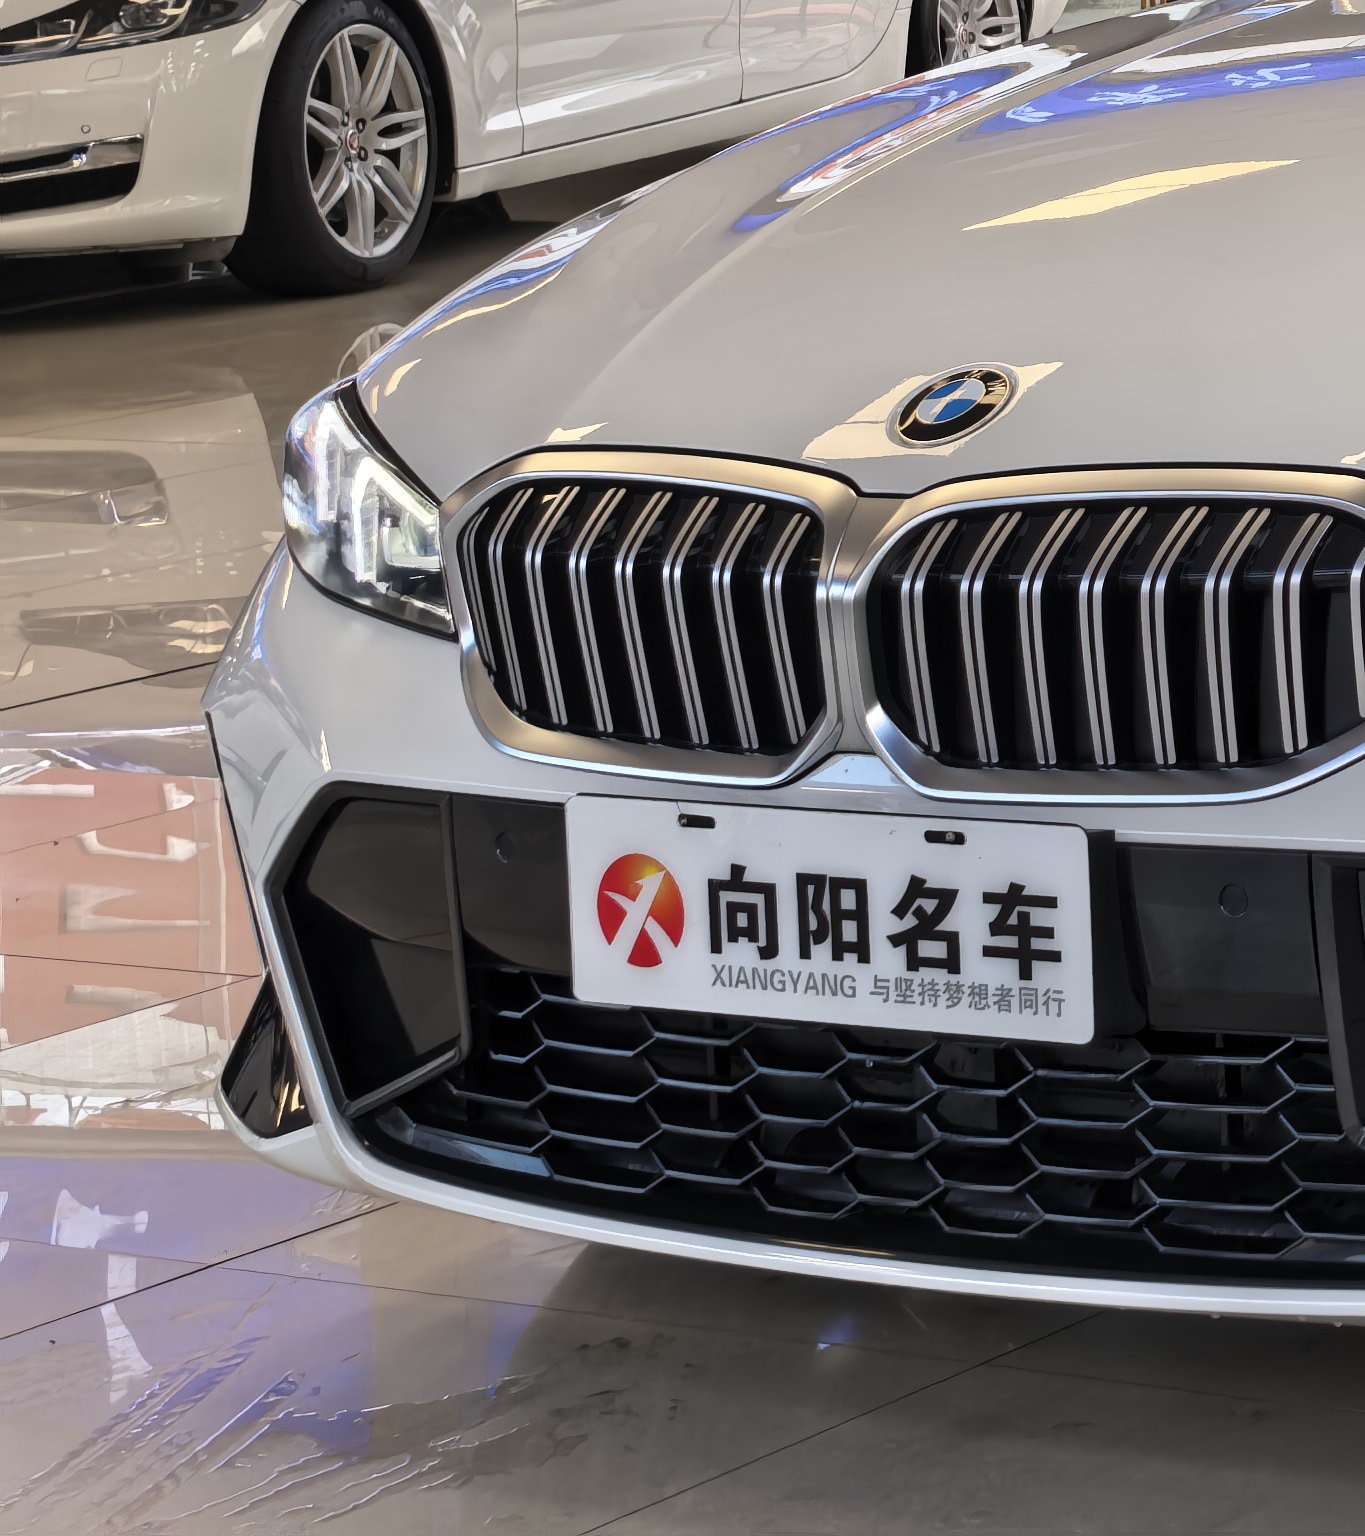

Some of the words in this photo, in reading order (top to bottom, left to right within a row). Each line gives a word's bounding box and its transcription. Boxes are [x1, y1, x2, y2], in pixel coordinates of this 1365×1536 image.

[707, 862, 1063, 981] 向阳名车
[710, 963, 858, 999] XIANGYANG
[869, 975, 1066, 1018] 与坚持梦想者同行
